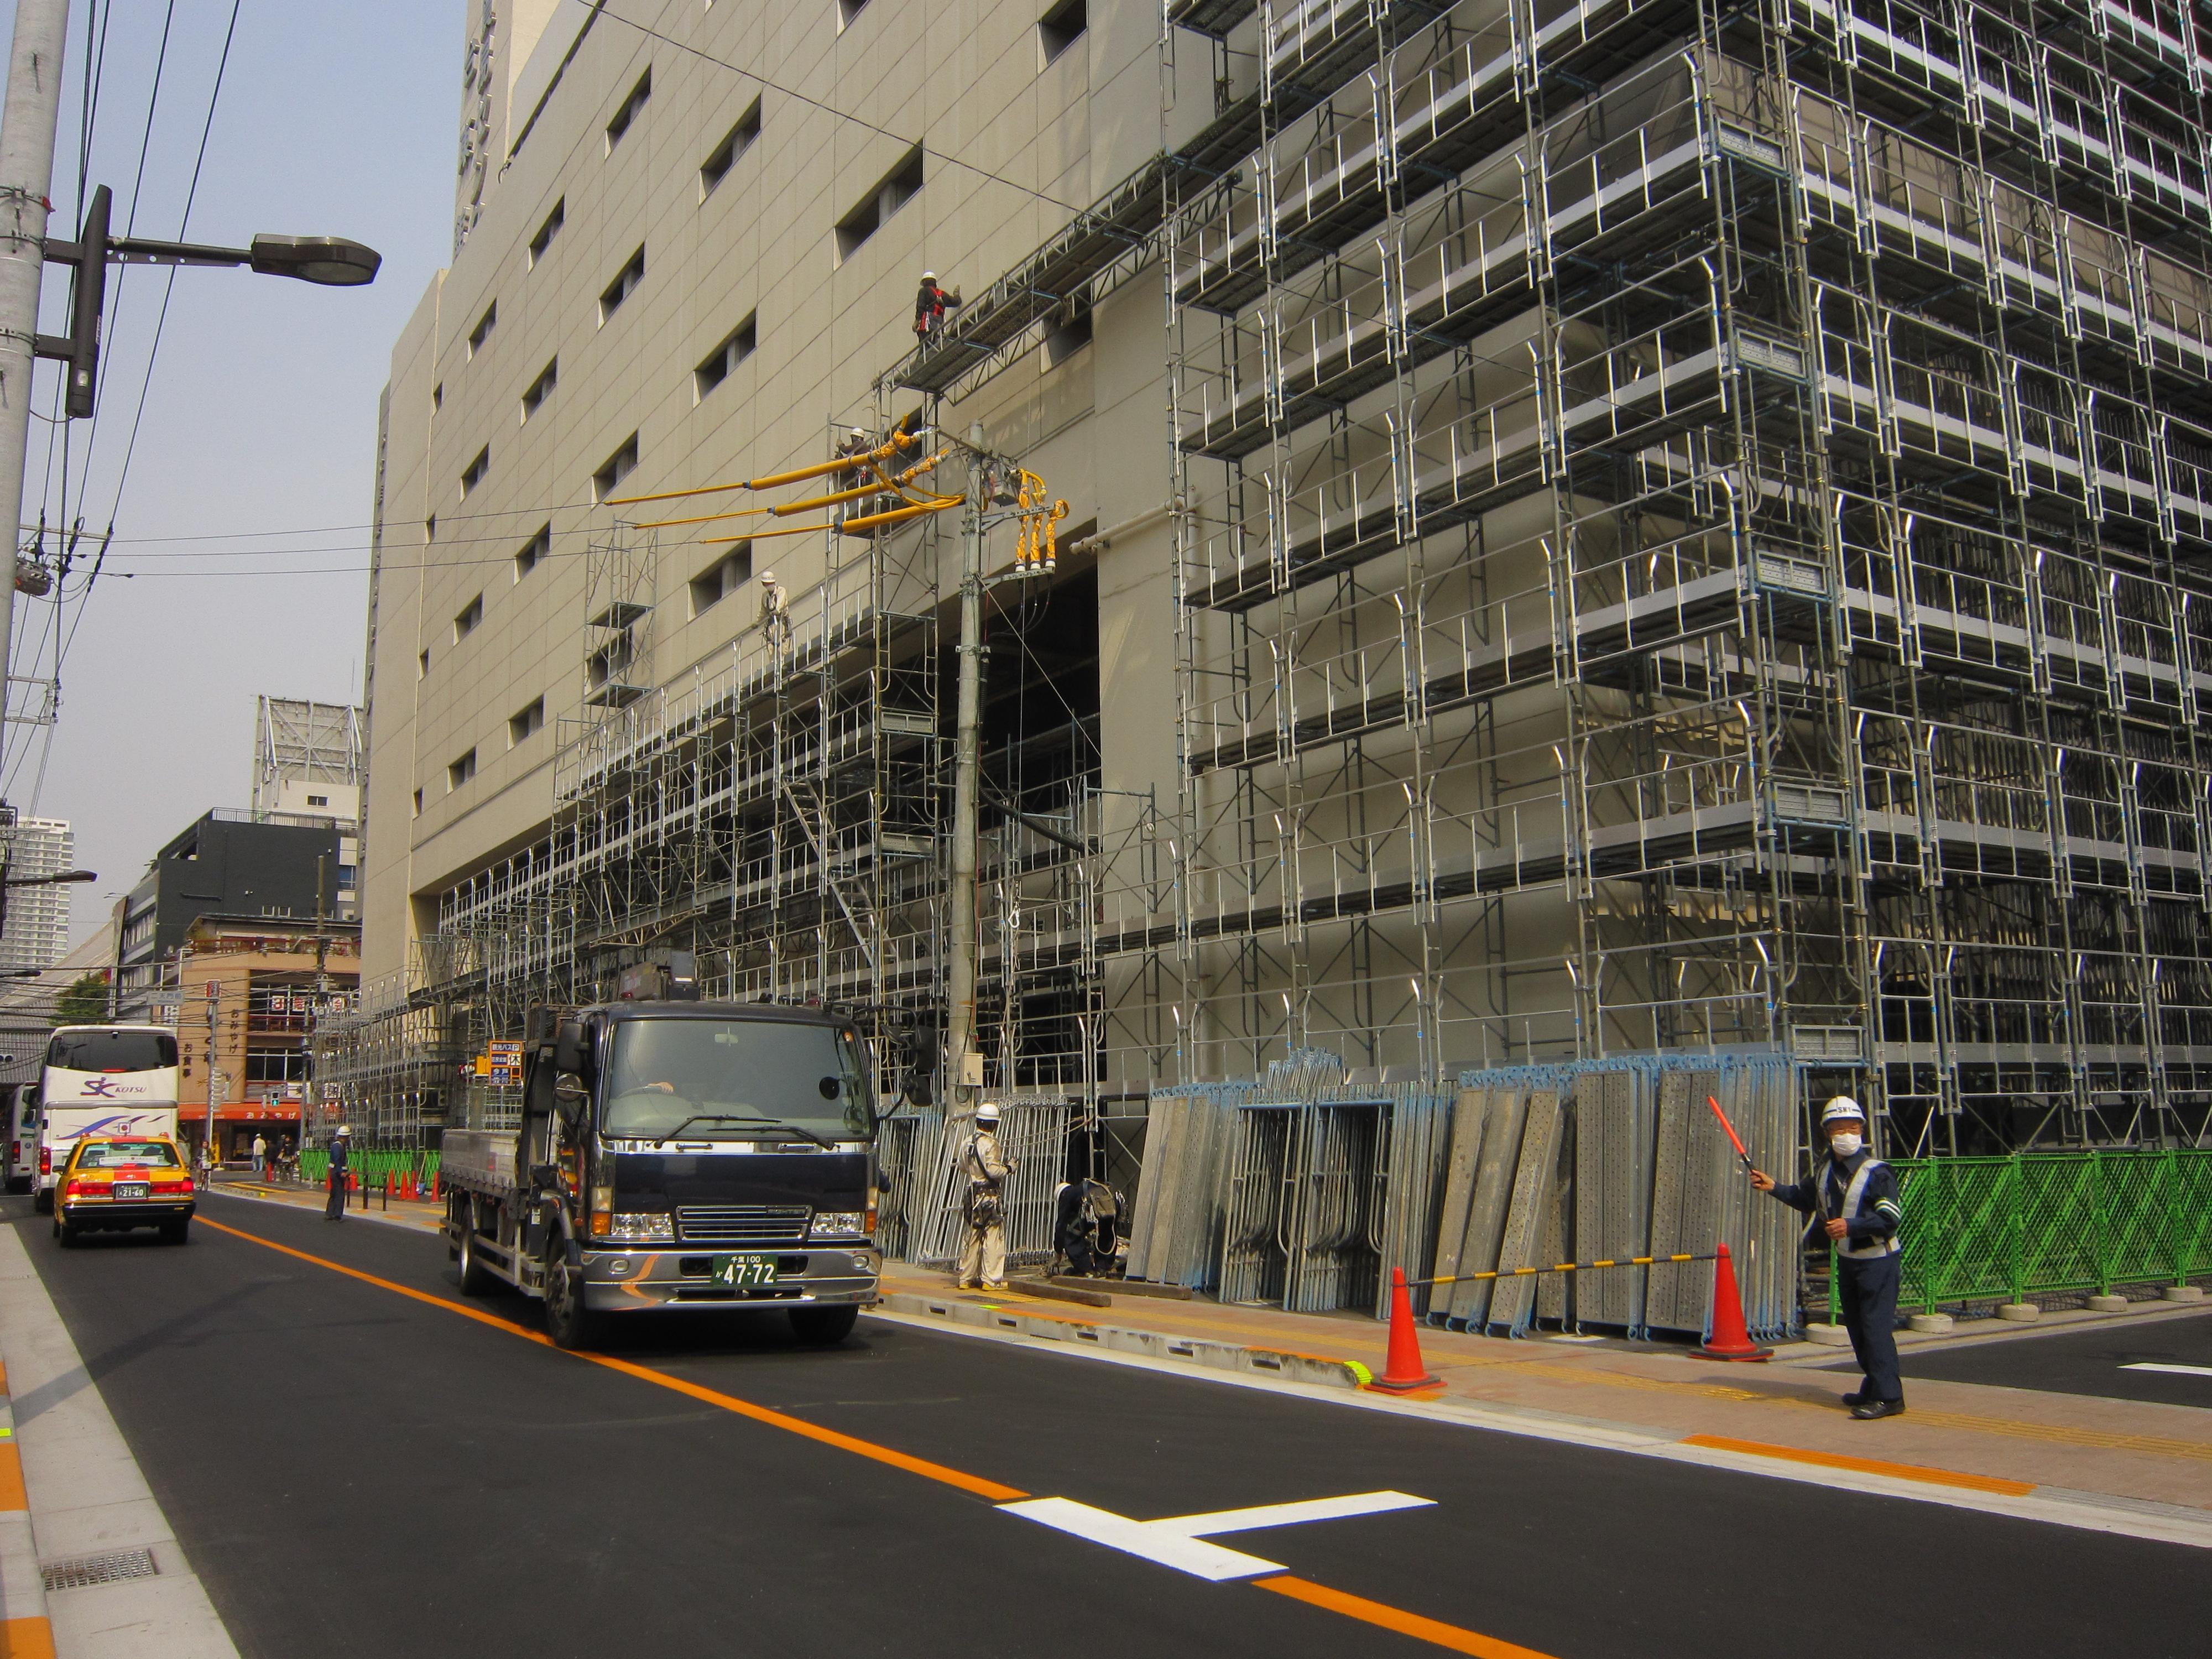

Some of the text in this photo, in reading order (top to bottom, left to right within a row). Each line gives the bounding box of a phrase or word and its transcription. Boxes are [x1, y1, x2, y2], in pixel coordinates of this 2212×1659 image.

[229, 1009, 239, 1053] おみやげ
[509, 1055, 520, 1065] 休
[723, 1264, 774, 1284] 47-72
